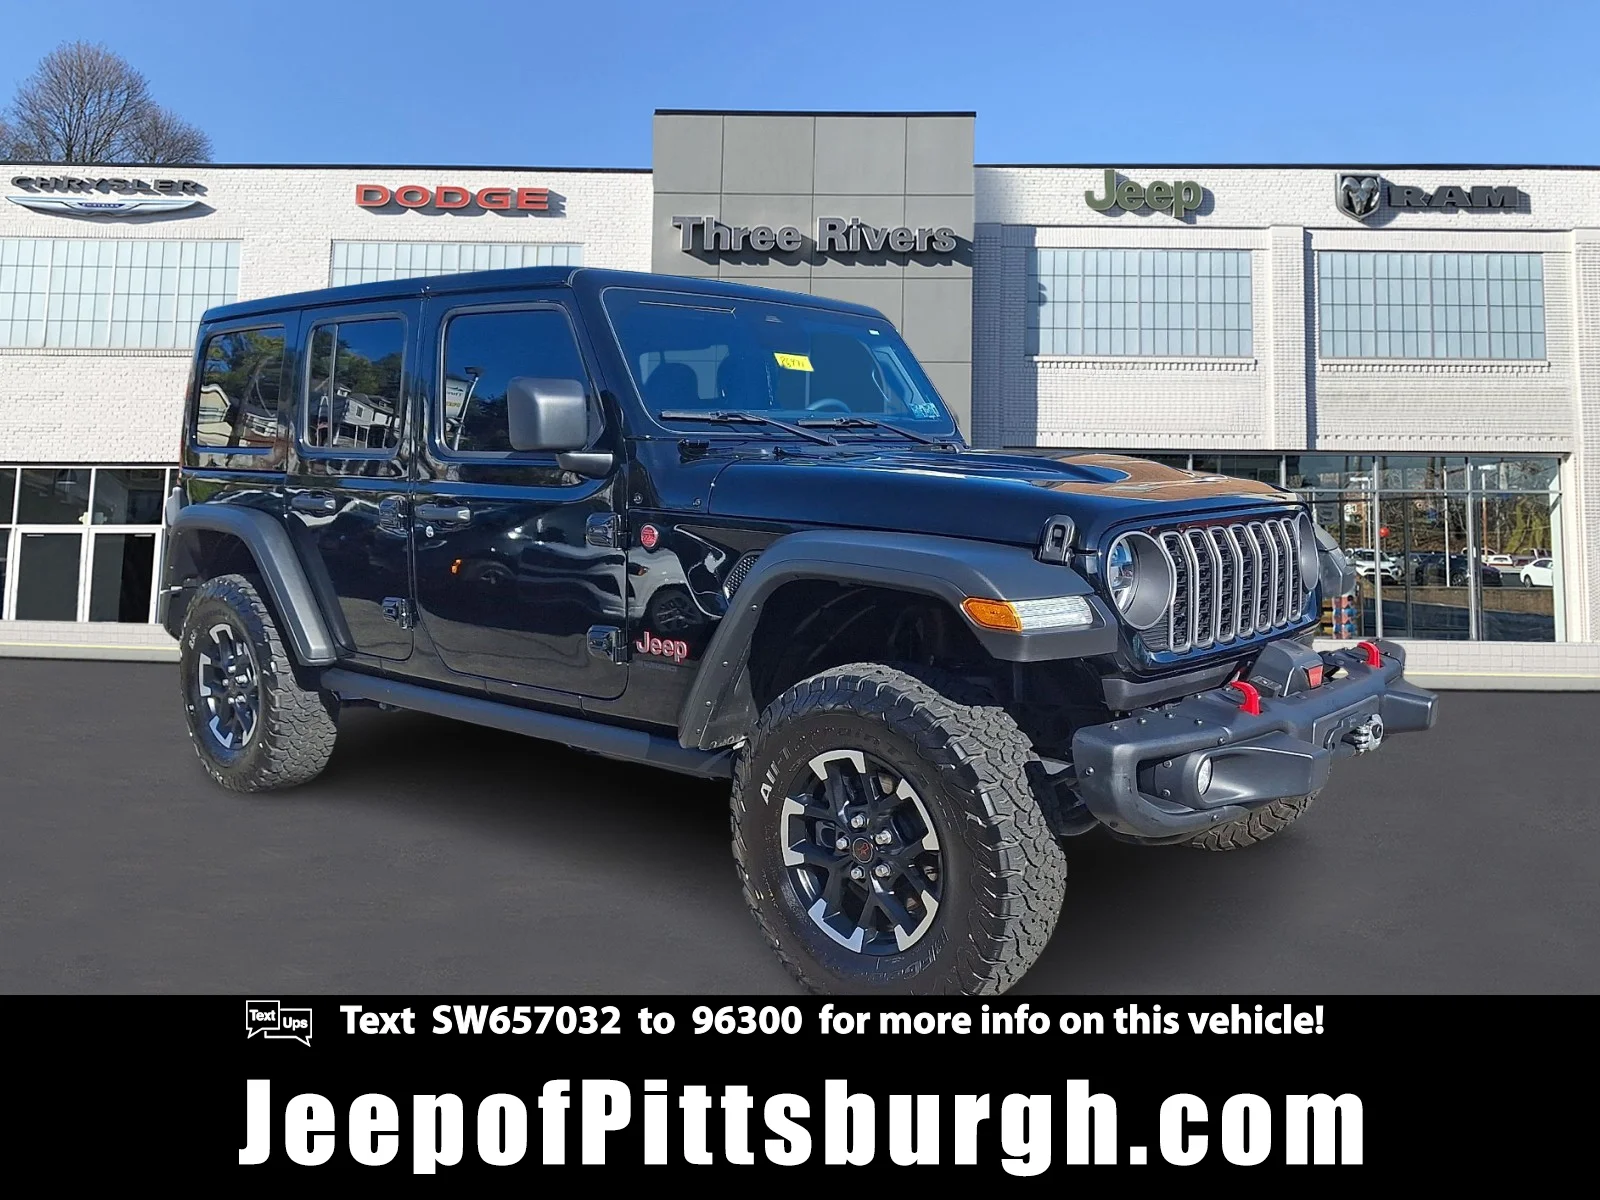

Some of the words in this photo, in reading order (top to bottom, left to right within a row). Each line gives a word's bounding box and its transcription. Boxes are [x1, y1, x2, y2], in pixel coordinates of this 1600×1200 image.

[11, 175, 199, 194] CHRYSLER
[356, 184, 549, 210] DODGE
[1084, 168, 1203, 218] Jeep
[1388, 185, 1519, 208] RAM
[672, 216, 801, 252] Three
[816, 216, 957, 253] Rivers
[635, 631, 688, 662] Jeep
